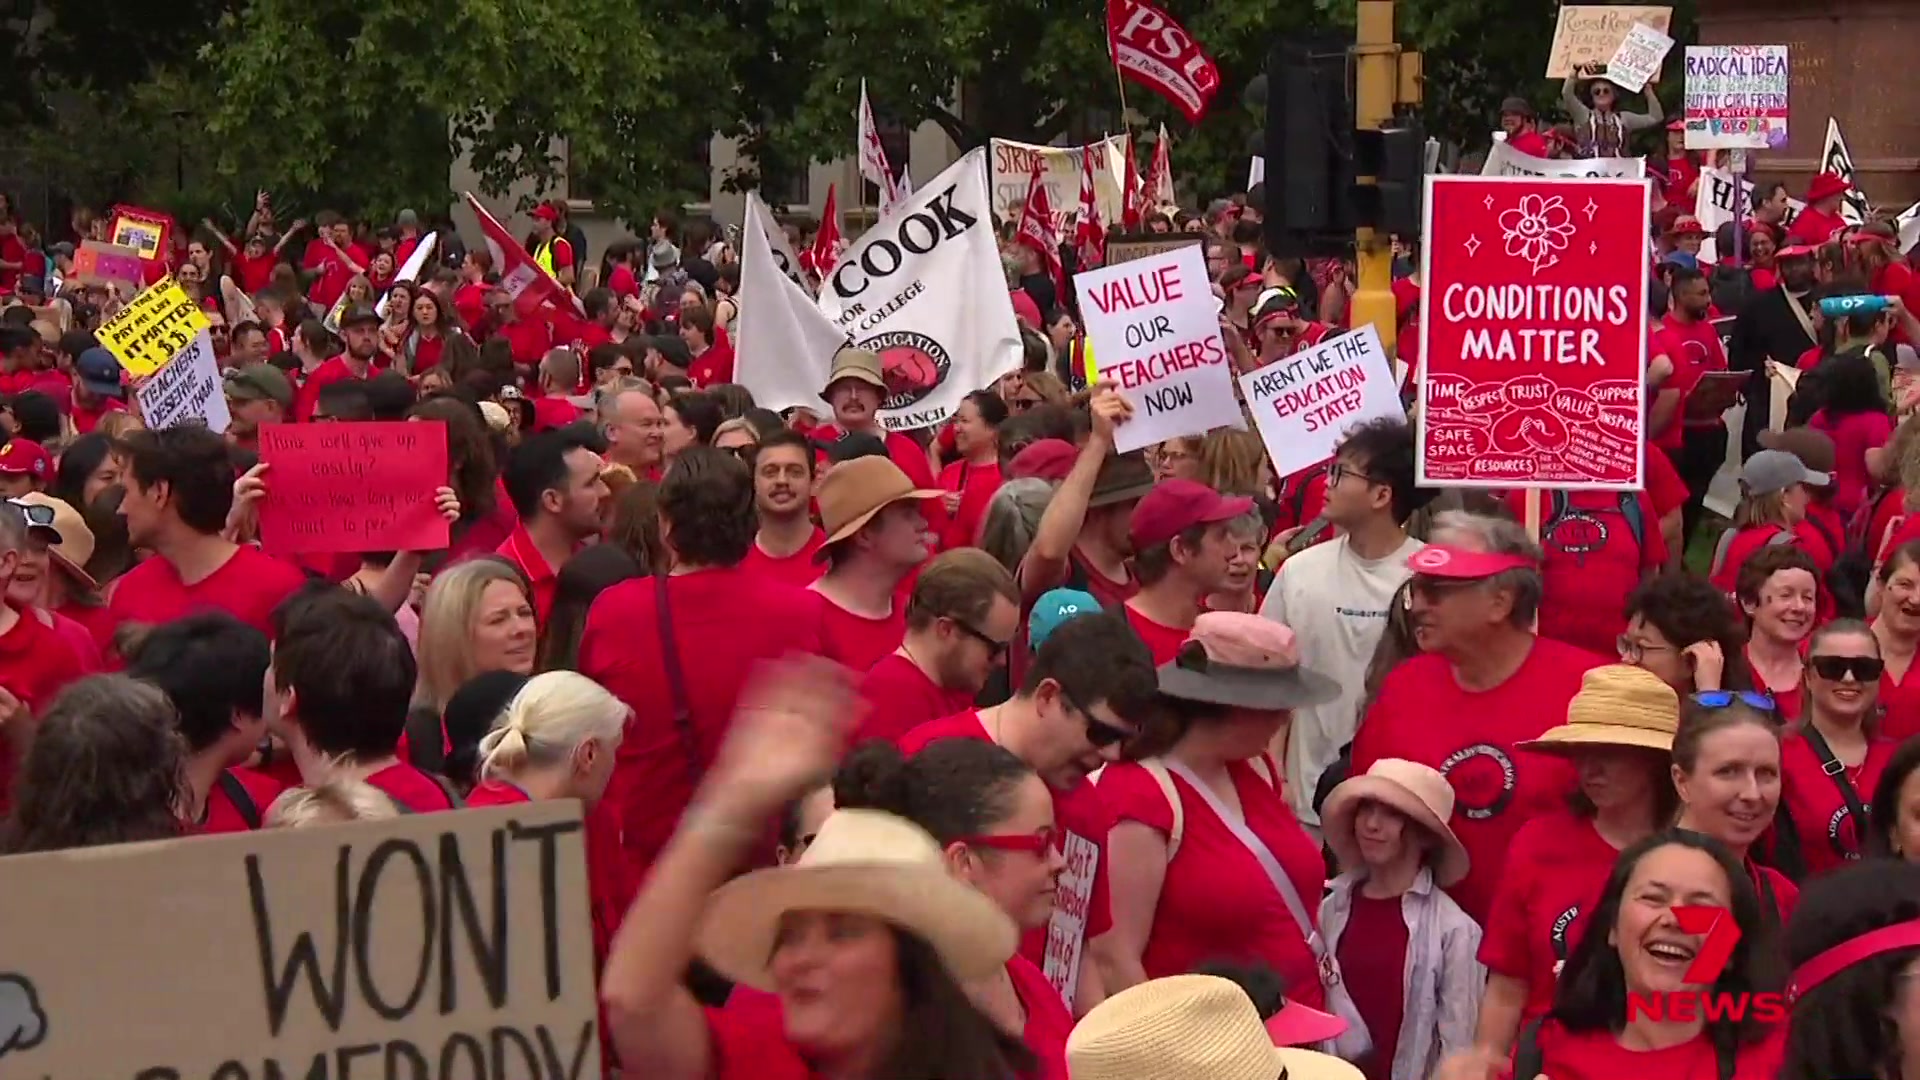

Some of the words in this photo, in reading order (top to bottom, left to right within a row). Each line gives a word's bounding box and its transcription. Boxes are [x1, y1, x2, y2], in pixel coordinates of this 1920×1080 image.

[1686, 56, 1747, 75] RADICAL
[1751, 56, 1787, 75] IDEA
[1731, 47, 1760, 56] NOT
[831, 184, 978, 298] COOK
[860, 280, 926, 331] COLLEGE
[1088, 265, 1183, 314] VALUE
[1442, 283, 1628, 326] CONDITIONS
[1125, 315, 1174, 348] OUR
[1460, 328, 1606, 366] MATTER
[124, 340, 142, 360] IT
[1099, 336, 1223, 392] TEACHERS
[1307, 349, 1334, 375] WE
[1333, 332, 1370, 361] THE
[140, 341, 200, 408] TEACHERS
[1273, 364, 1366, 418] EDUCATION
[1426, 379, 1465, 402] TIME
[150, 370, 199, 428] DESERVE
[190, 376, 215, 414] THAN
[1144, 382, 1193, 416] NOW
[1462, 388, 1504, 411] RESPECT
[1509, 383, 1550, 400] TRUST
[1554, 395, 1597, 419] VALUE
[1591, 386, 1639, 402] SUPPORT
[884, 405, 947, 429] BRANCH
[1303, 390, 1363, 432] STATE?
[397, 434, 417, 452] up
[1428, 444, 1477, 457] SPACE
[1433, 429, 1473, 442] SAFE
[1474, 459, 1534, 473] RESOURCES
[1058, 604, 1078, 615] AO
[243, 819, 583, 1037] WON'T
